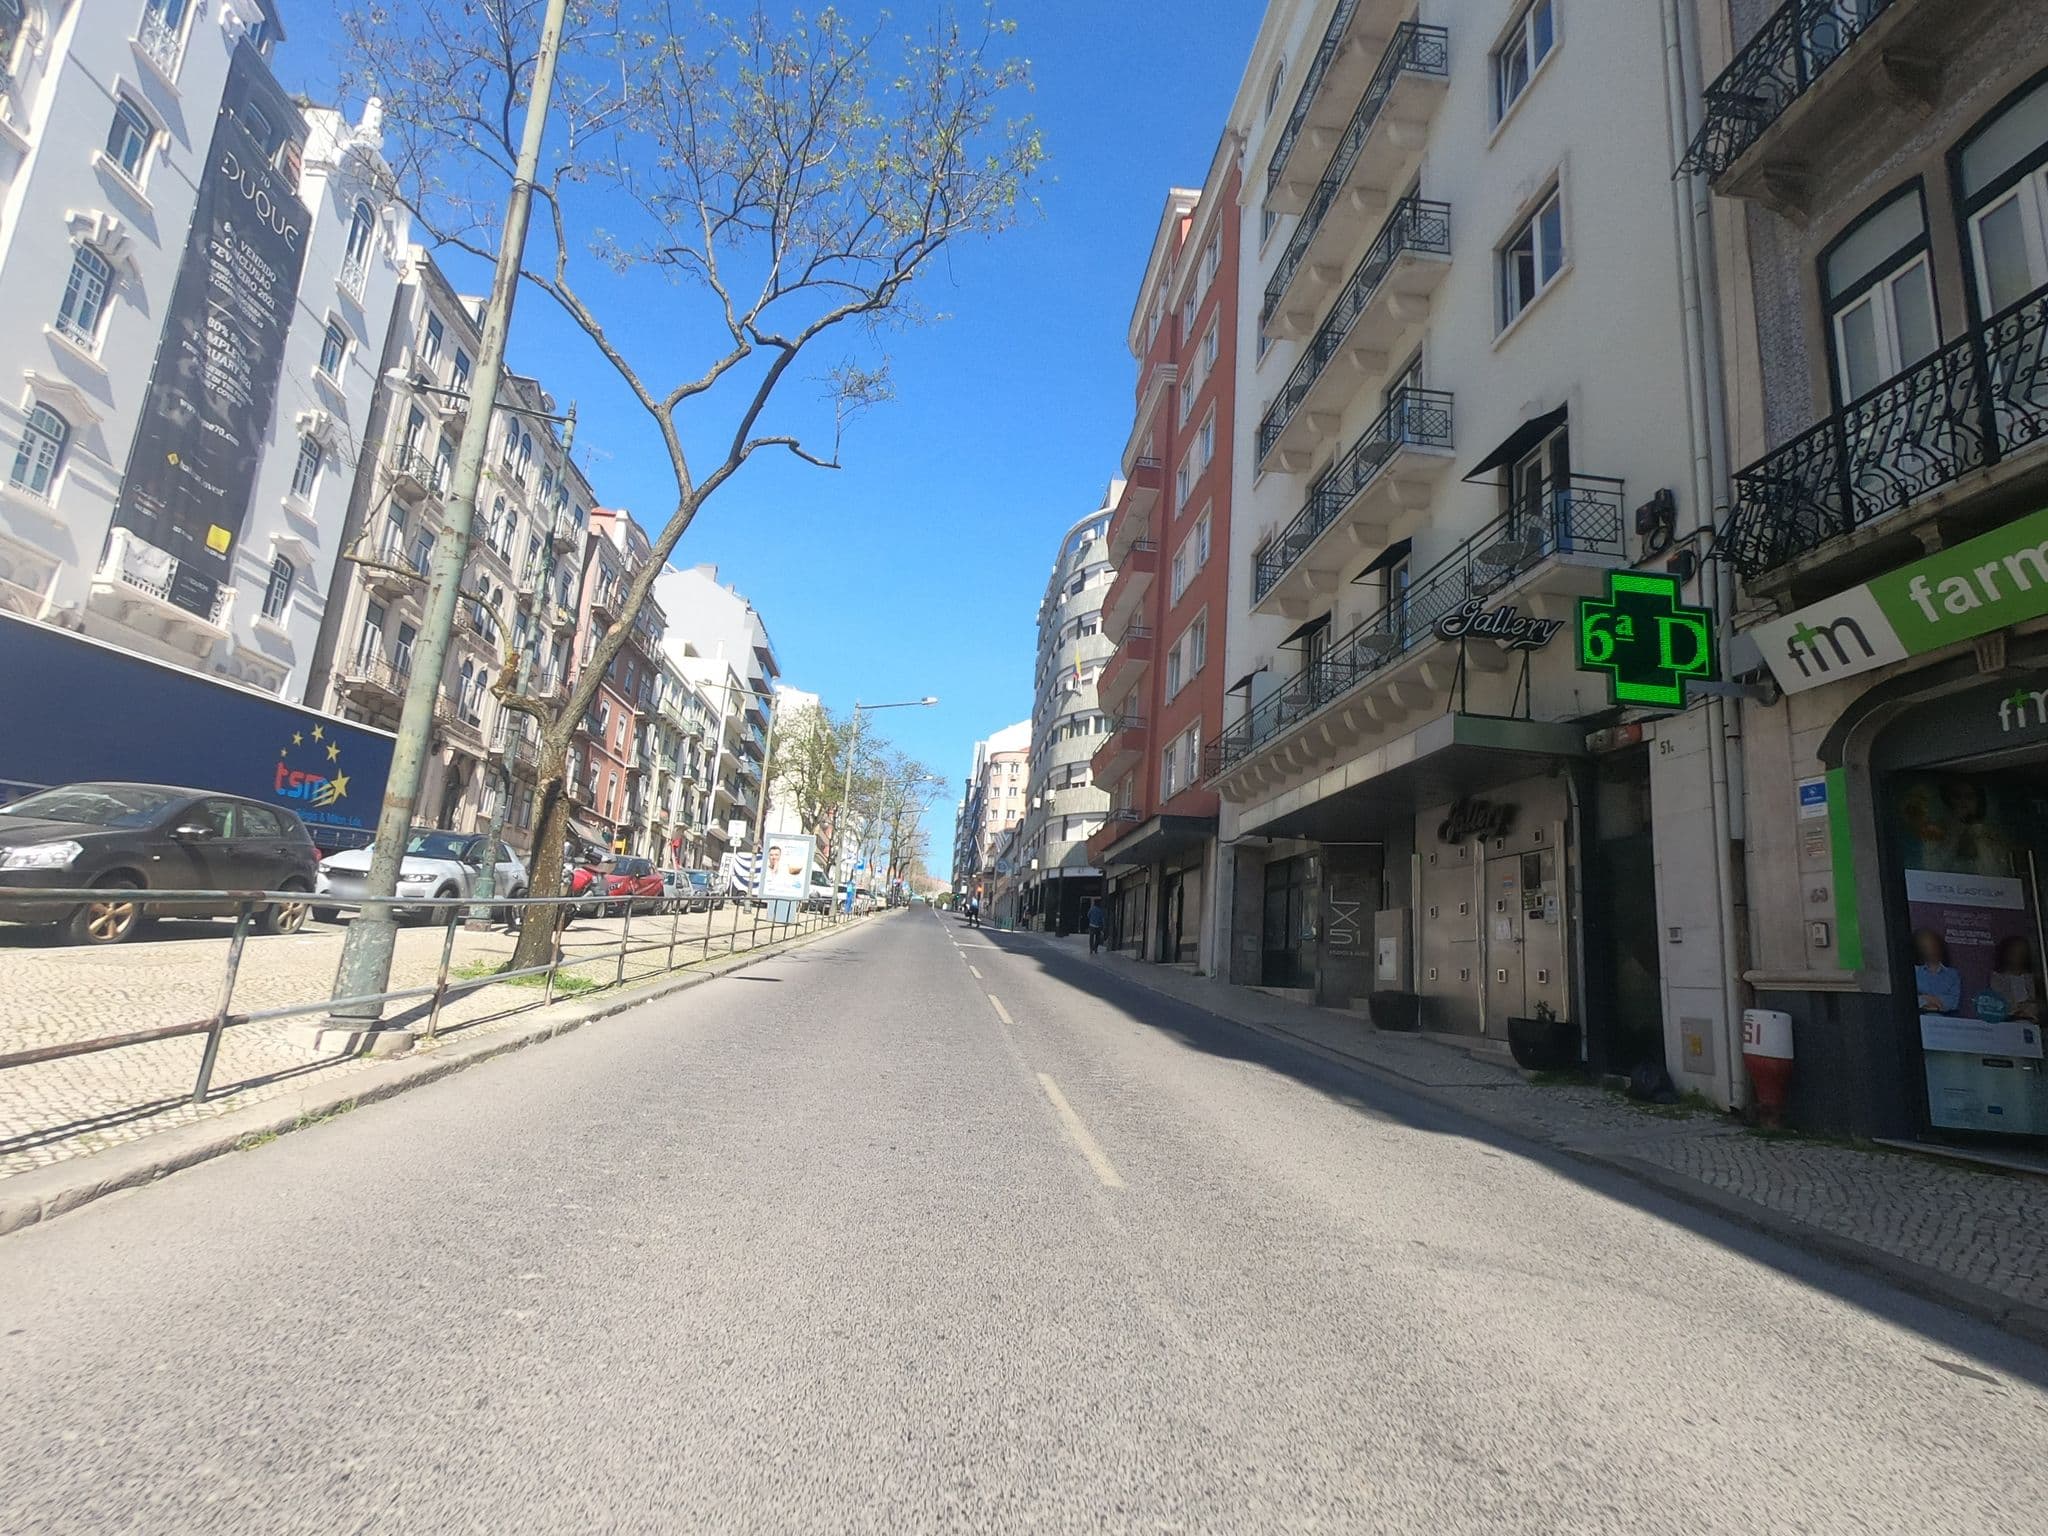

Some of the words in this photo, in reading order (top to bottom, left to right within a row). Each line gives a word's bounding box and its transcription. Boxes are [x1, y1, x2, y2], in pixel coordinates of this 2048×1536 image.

[221, 151, 299, 253] DUQUE
[1440, 595, 1568, 649] Gallery
[1653, 615, 1707, 671] D
